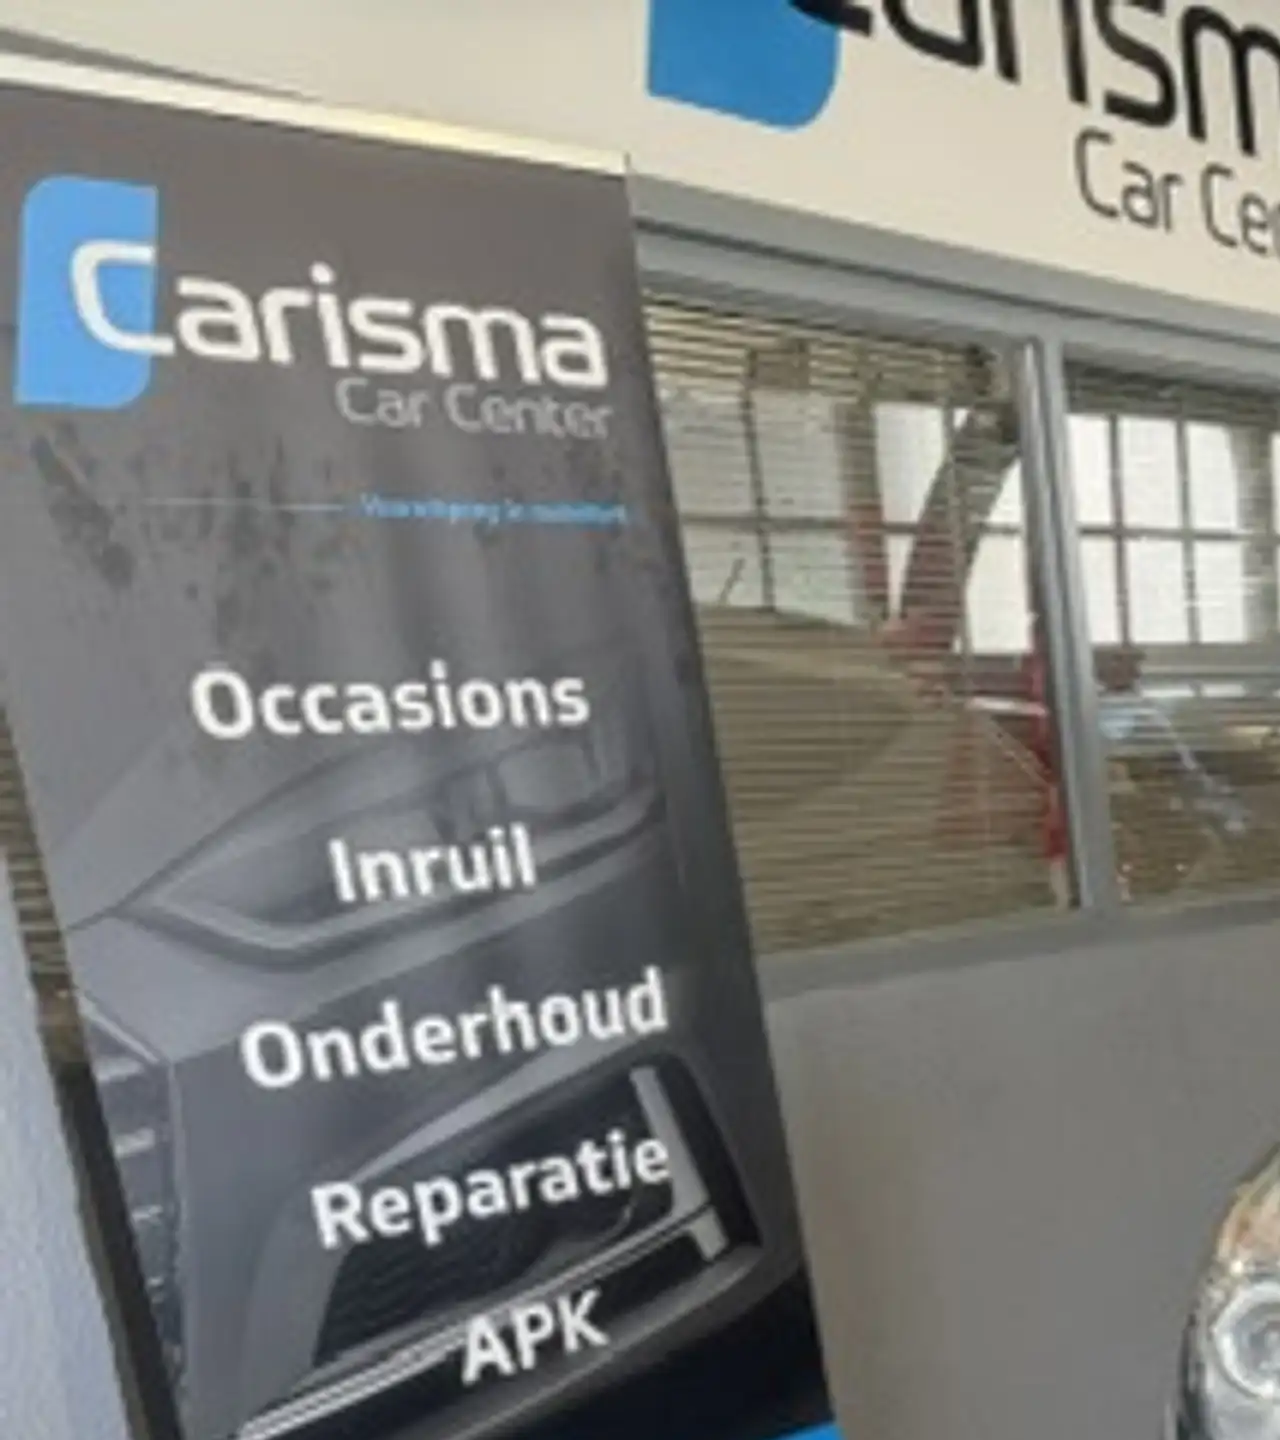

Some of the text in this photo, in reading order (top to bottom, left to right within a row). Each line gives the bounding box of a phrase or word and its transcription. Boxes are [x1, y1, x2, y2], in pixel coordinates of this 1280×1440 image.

[1074, 128, 1184, 232] Car
[70, 240, 607, 388] Carisma
[335, 377, 614, 439] Car Center
[191, 660, 589, 738] Occasions
[329, 825, 537, 901] Inruil
[239, 966, 668, 1088] Onderhoud
[311, 1129, 671, 1248] Reparatie
[460, 1289, 608, 1383] APK
